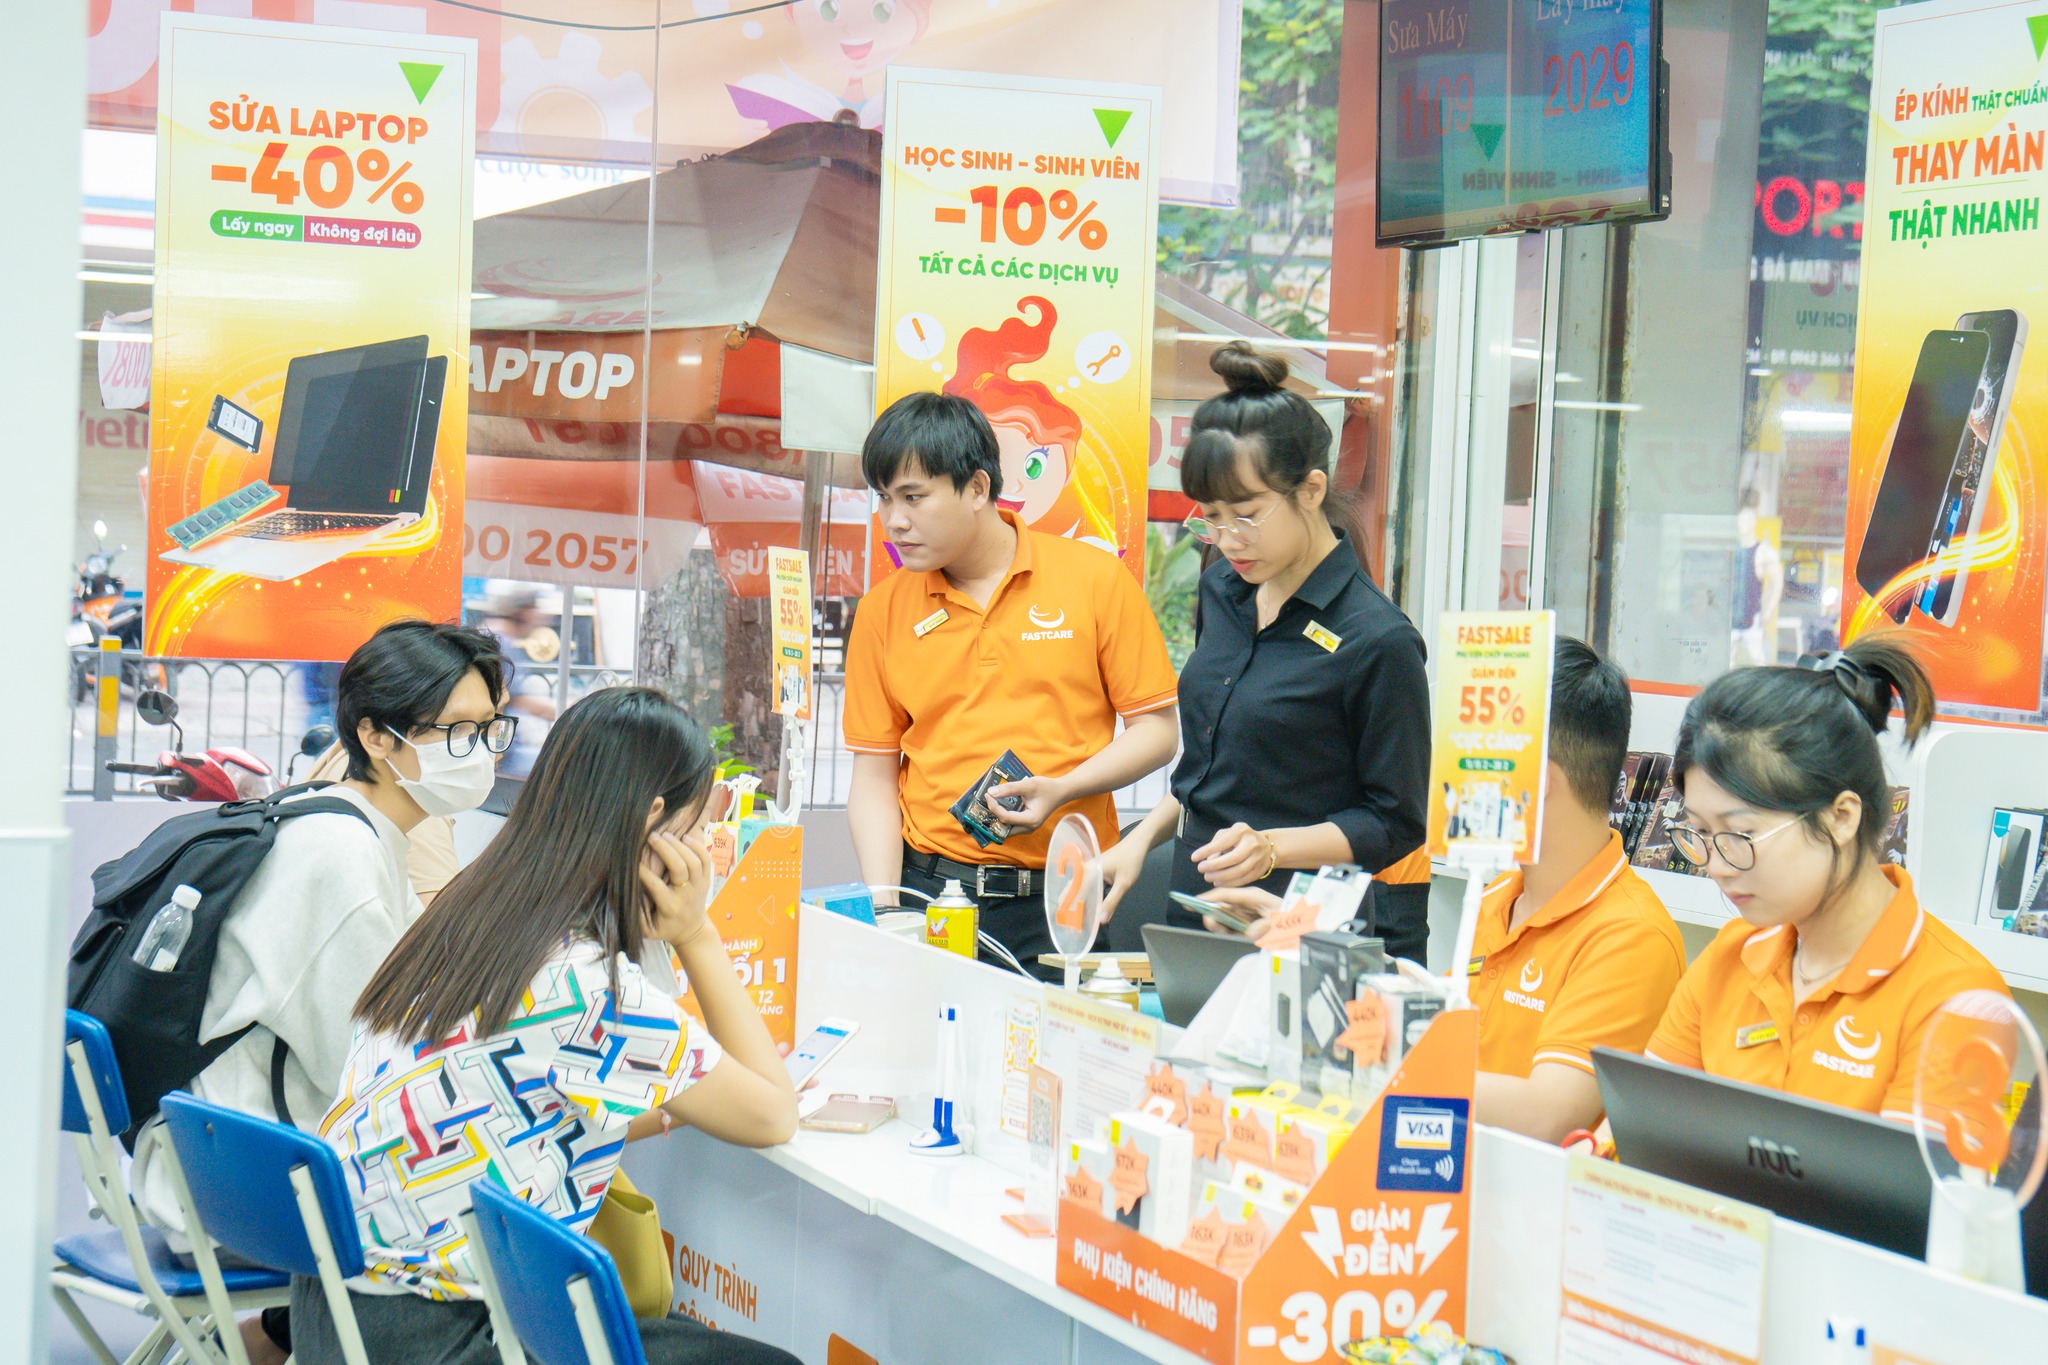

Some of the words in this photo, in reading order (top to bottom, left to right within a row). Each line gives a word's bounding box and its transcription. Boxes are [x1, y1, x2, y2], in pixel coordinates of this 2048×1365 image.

[1426, 6, 1468, 48] Máy
[1543, 41, 1634, 118] 2029
[208, 94, 281, 134] SỬA
[290, 108, 428, 144] LAPTOP
[1400, 73, 1473, 142] 1109
[1895, 88, 1918, 122] ÉP
[1921, 83, 1969, 118] KÍNH
[1972, 90, 2002, 115] THẬT
[2004, 80, 2048, 108] CHUẨN
[904, 146, 955, 172] HỌC
[961, 150, 1013, 171] SINH
[1034, 155, 1085, 176] SINH
[1090, 155, 1140, 180] VIÊN
[1893, 139, 1968, 185] THAY
[1974, 122, 2045, 177] MÀN
[211, 142, 424, 214] -40%
[222, 216, 251, 235] Lấy
[254, 223, 294, 237] ngay
[310, 222, 361, 241] Không
[364, 226, 389, 244] đợi
[391, 228, 416, 243] lâu
[935, 185, 1108, 250] -10%
[1889, 199, 1947, 250] THẬT
[1951, 197, 2039, 237] NHANH
[919, 250, 953, 274] TẤT
[957, 254, 986, 276] CẢ
[991, 257, 1034, 280] CÁC
[1039, 264, 1087, 286] DỊCH
[1092, 266, 1119, 289] VỤ
[524, 529, 648, 574] 2057
[776, 557, 802, 574] FASTSALE
[780, 598, 804, 628] 55%
[1021, 630, 1074, 641] FASTCARE
[1457, 626, 1532, 645] FASTSALE
[1459, 686, 1525, 726] 55%
[1055, 842, 1086, 932] 2
[758, 990, 774, 1004] 12
[1945, 1041, 2009, 1169] 3
[1407, 1121, 1444, 1136] VISA
[1350, 1201, 1411, 1231] GIẢM
[1343, 1228, 1414, 1276] ĐẾN
[680, 1245, 710, 1293] QUY
[714, 1262, 757, 1323] TRÌNH
[1074, 1237, 1100, 1280] PHỤ
[1102, 1251, 1132, 1292] KIỆN
[1134, 1266, 1176, 1312] CHÍNH
[1178, 1286, 1218, 1332] HÃNG
